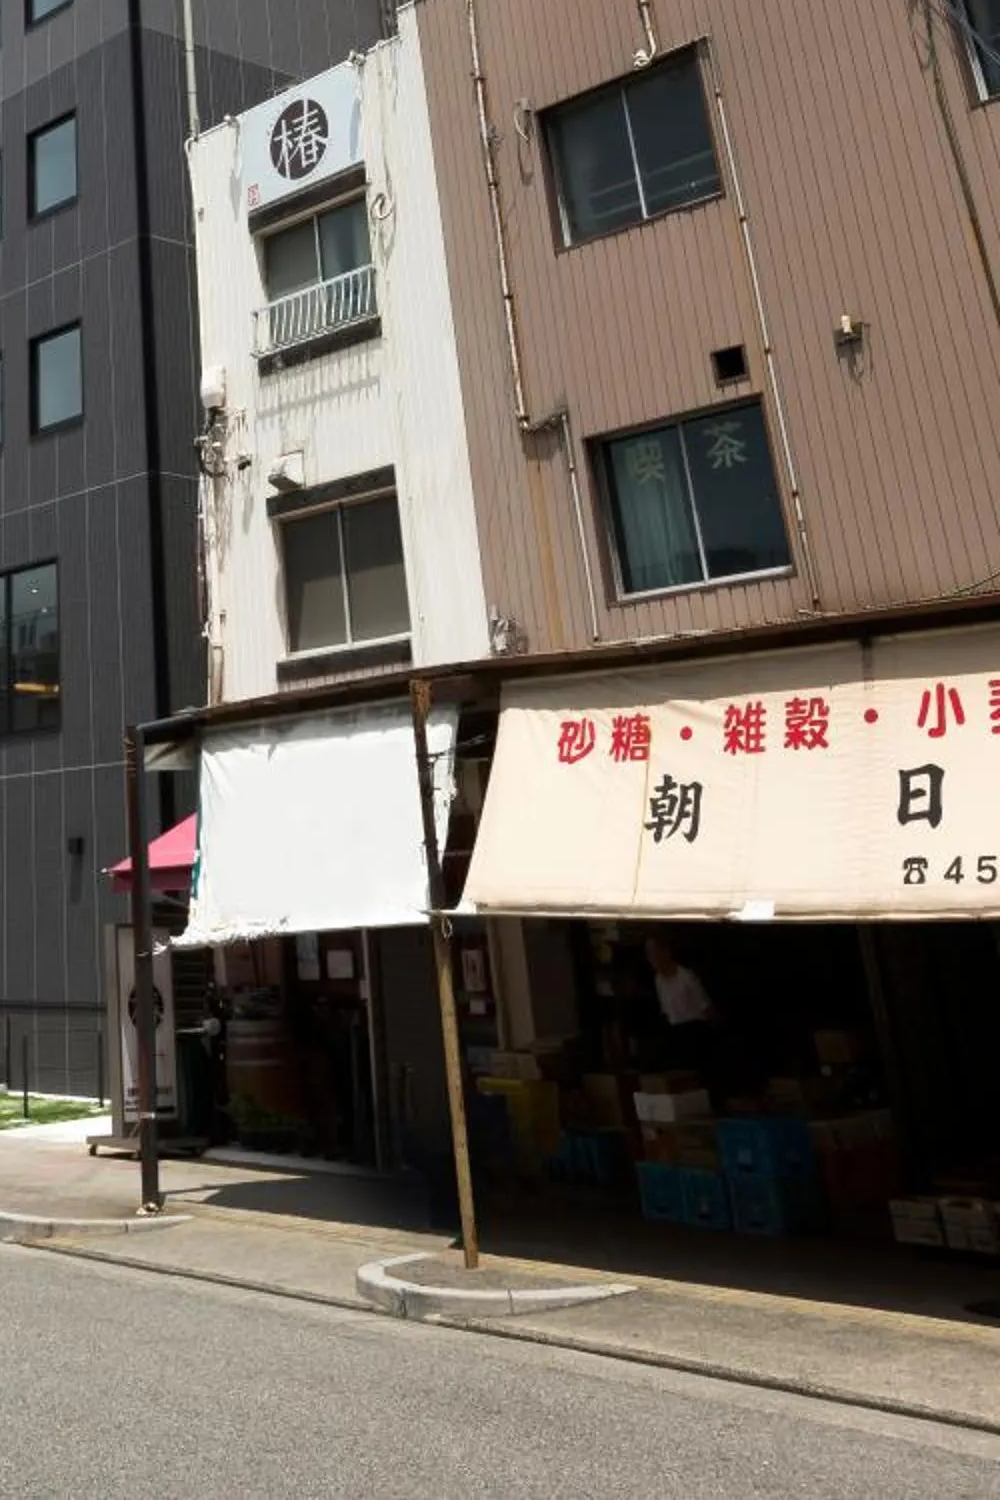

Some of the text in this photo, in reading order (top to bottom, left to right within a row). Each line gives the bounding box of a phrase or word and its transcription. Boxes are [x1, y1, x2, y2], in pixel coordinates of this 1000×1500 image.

[273, 97, 329, 181] 椿
[556, 679, 1000, 765] 砂糖・雑穀・小
